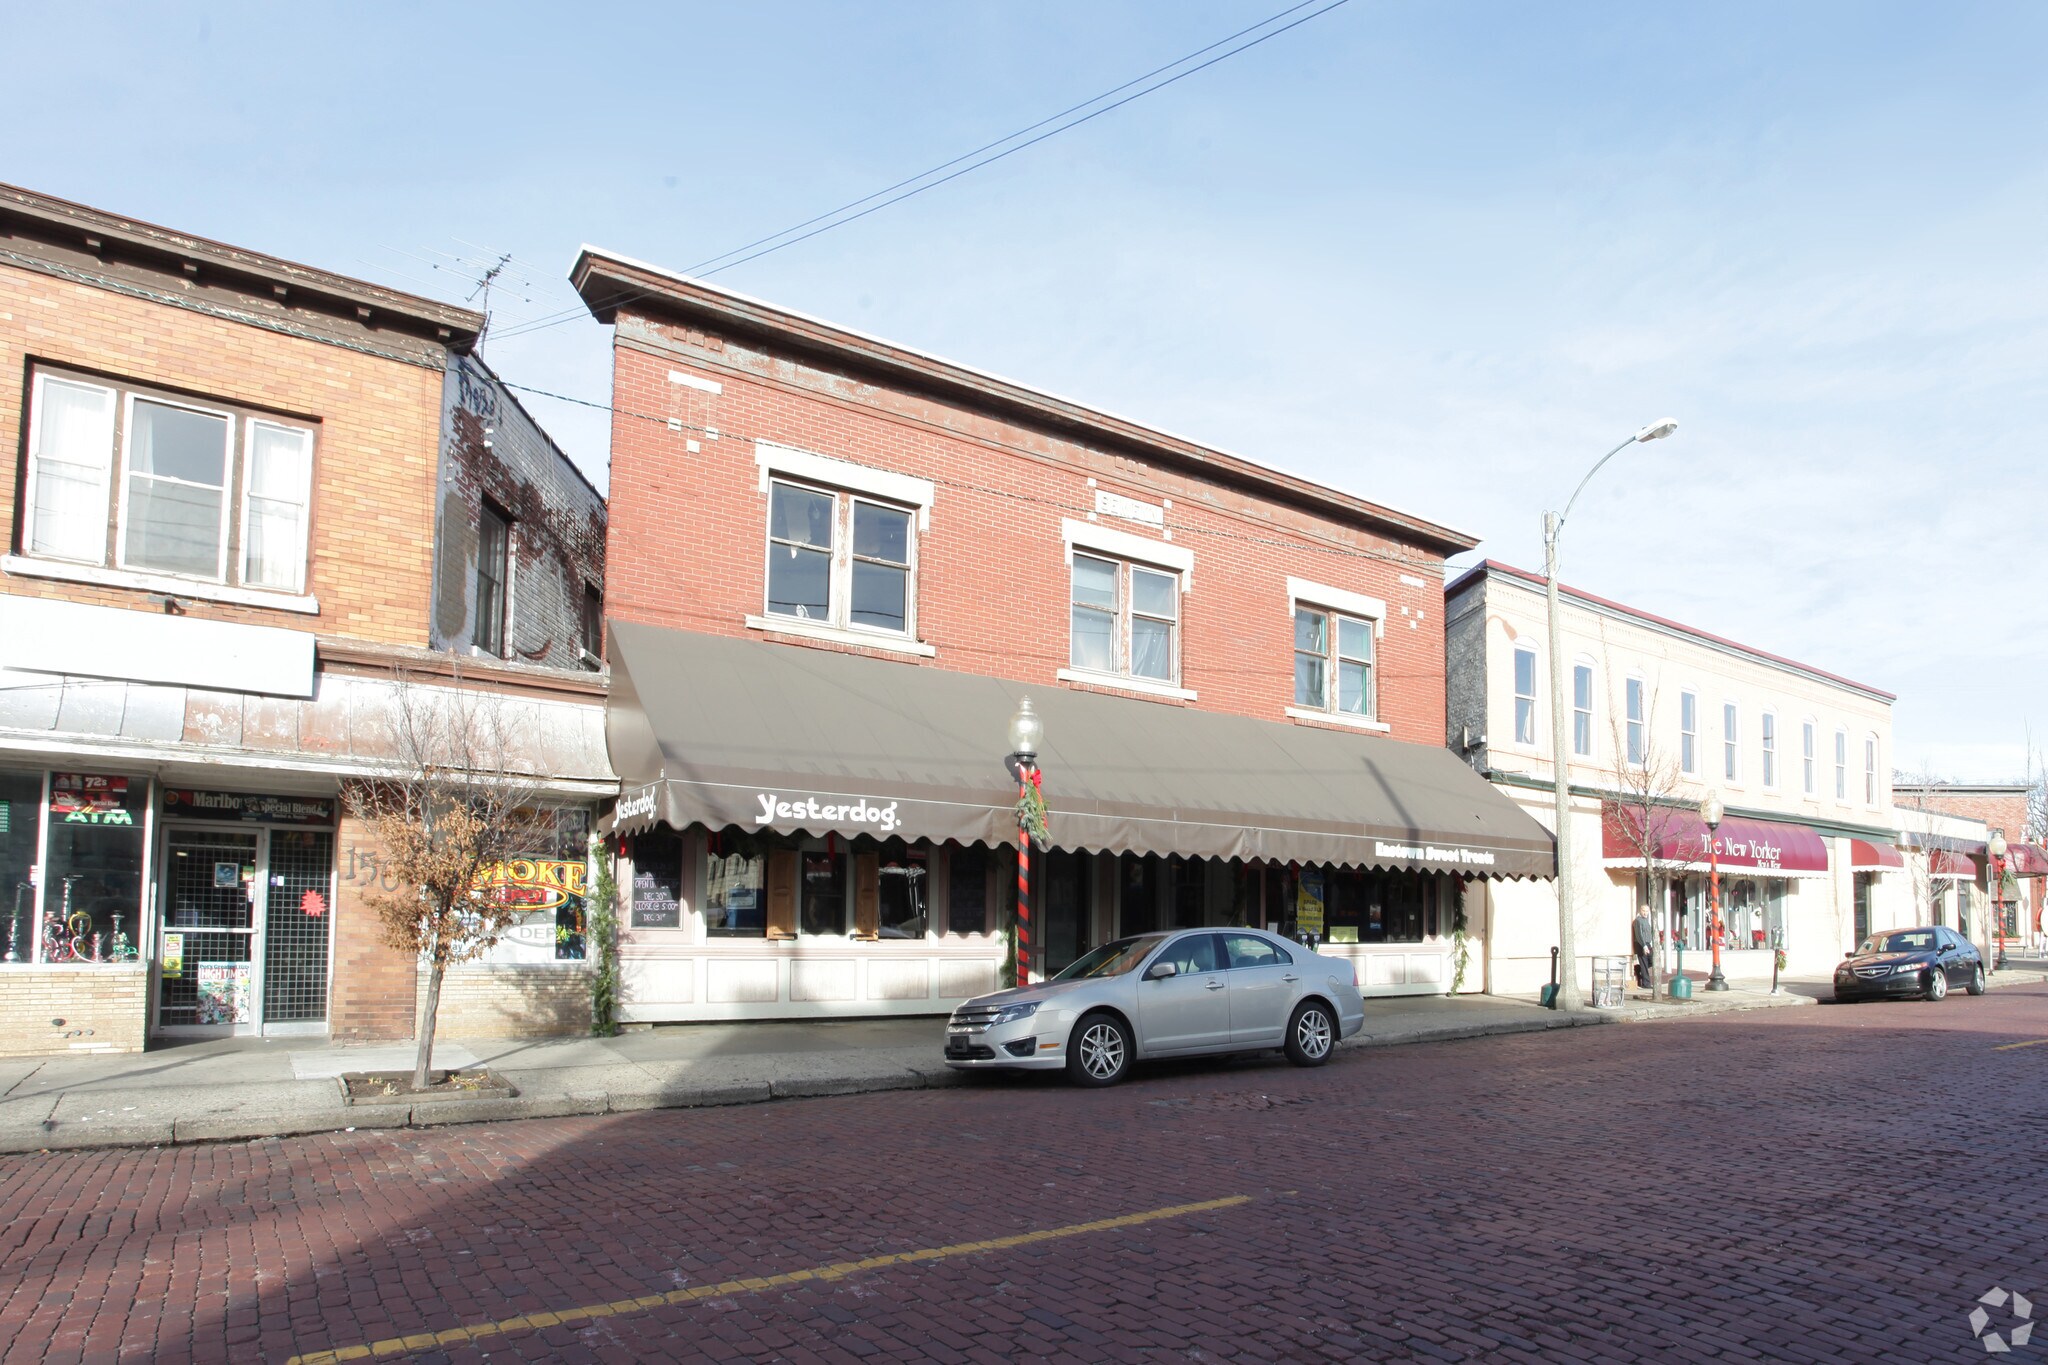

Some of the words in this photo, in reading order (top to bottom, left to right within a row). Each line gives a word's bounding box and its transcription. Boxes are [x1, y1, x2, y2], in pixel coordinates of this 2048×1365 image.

[192, 791, 243, 809] Marlbo
[261, 800, 291, 814] Special
[292, 802, 316, 814] Blend
[65, 811, 133, 825] ATM
[756, 793, 901, 831] Yesterdog.
[1375, 841, 1424, 860] Eastown
[1425, 846, 1460, 863] Sweet
[1460, 848, 1495, 865] Treats
[1725, 836, 1747, 857] New
[1748, 839, 1781, 860] Yorker
[470, 858, 588, 898] MOKE
[490, 887, 549, 903] EPOT
[519, 927, 556, 941] DEP
[200, 968, 221, 980] HIGH
[221, 968, 249, 980] TIMES
